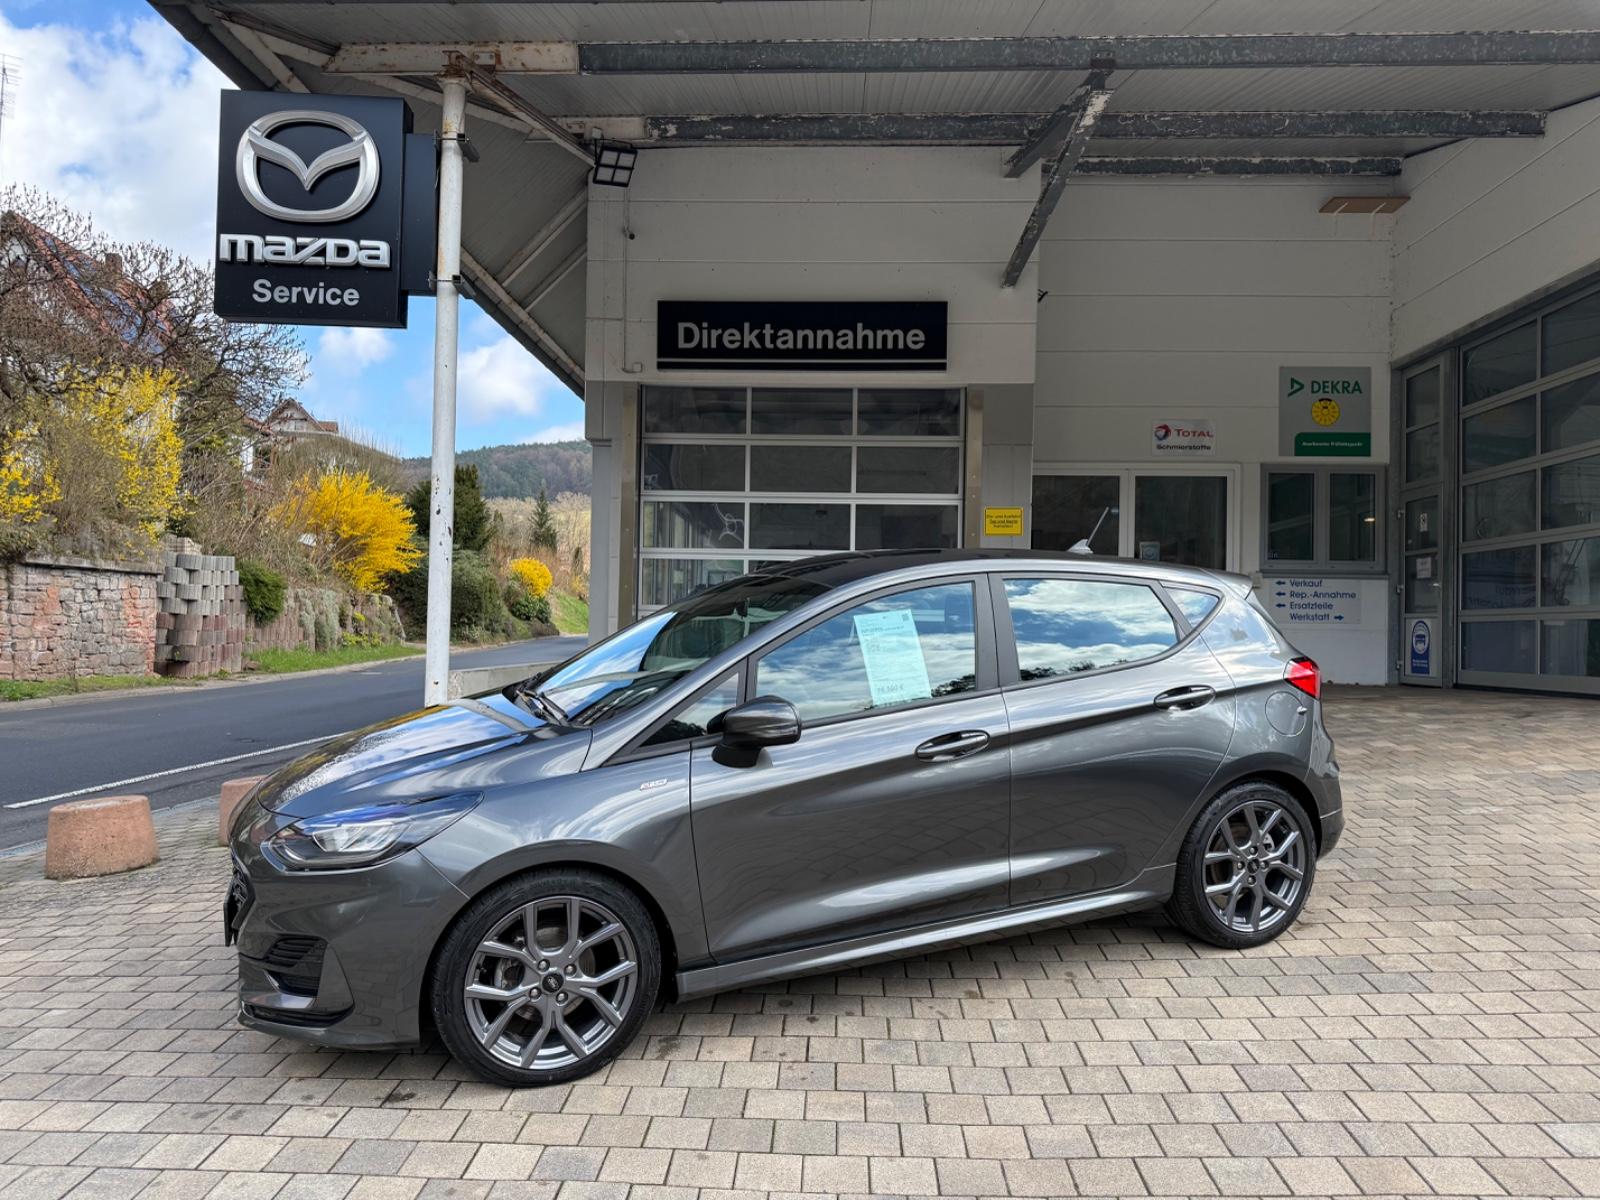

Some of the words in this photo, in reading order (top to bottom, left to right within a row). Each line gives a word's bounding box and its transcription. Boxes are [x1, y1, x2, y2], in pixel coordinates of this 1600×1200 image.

[252, 279, 360, 306] Service
[677, 322, 926, 350] Direktannahme
[1311, 380, 1363, 394] DEKRA
[1290, 580, 1323, 588] Verkauf
[1290, 591, 1357, 600] Rep.-Annahme
[1290, 602, 1334, 610] Ersatzteile
[1290, 613, 1330, 621] Werkstatt
